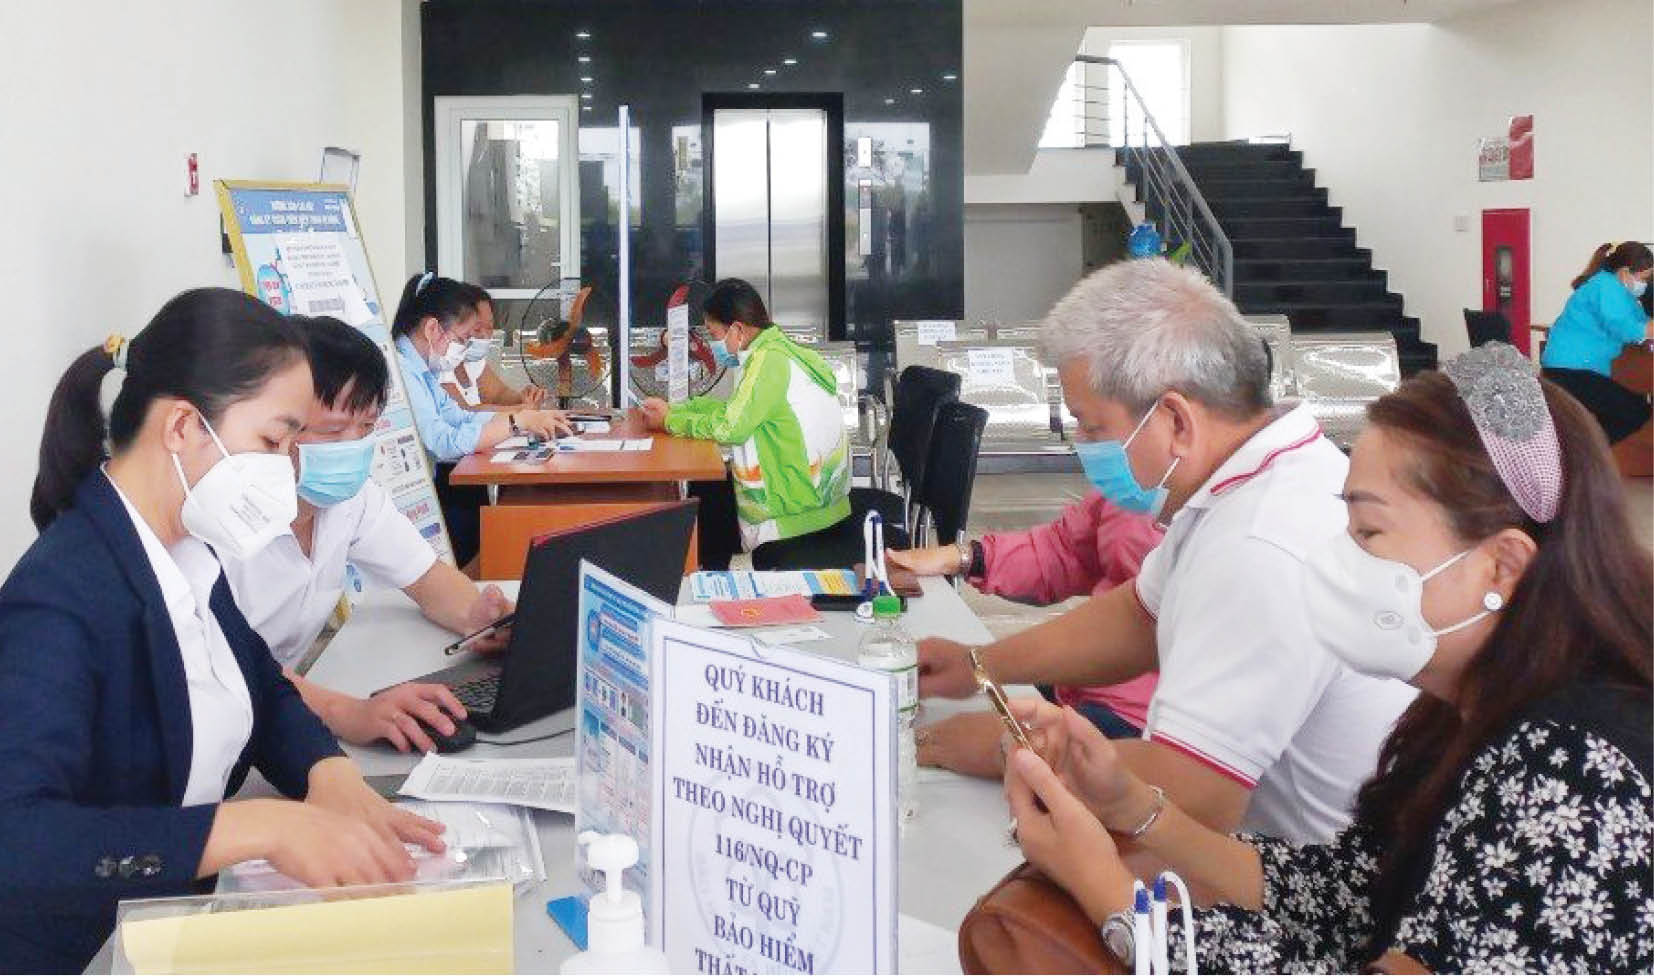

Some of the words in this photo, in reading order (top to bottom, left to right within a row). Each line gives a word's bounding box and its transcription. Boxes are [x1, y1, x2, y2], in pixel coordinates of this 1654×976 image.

[705, 664, 746, 694] QUÝ
[752, 677, 824, 716] KHÁCH
[696, 698, 738, 733] ĐẾN
[743, 713, 800, 752] ĐĂNG
[805, 731, 835, 763] KÝ
[695, 743, 751, 780] NHẬN
[757, 754, 786, 790] HỖ
[792, 773, 836, 813] TRỢ
[673, 776, 726, 813] THEO
[731, 795, 783, 839] NGHỊ
[788, 815, 863, 860] QUYẾT
[715, 833, 814, 886] 116/NQ-CP
[726, 876, 754, 907] TỪ
[758, 891, 801, 926] QUỸ
[713, 911, 753, 950] BẢO
[760, 931, 814, 975] HIỂM
